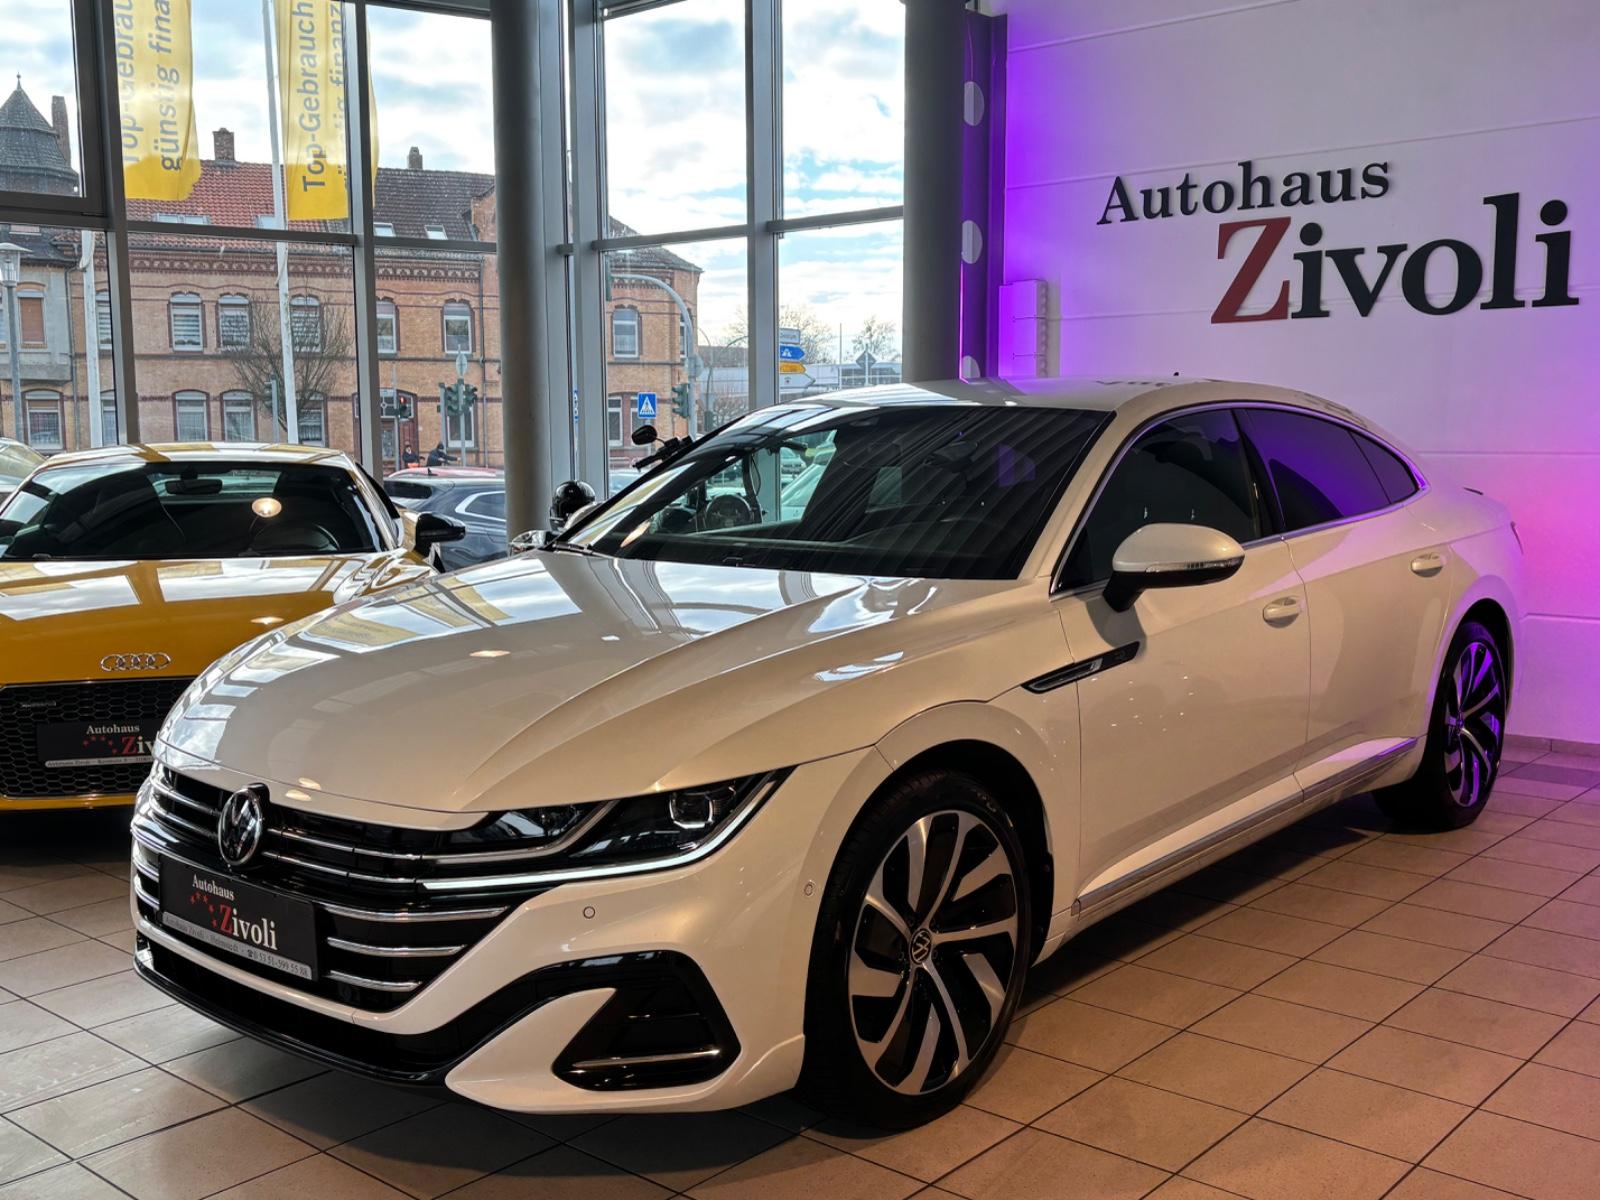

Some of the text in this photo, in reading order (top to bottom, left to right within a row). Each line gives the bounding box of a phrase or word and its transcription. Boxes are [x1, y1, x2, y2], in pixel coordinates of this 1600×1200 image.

[151, 64, 182, 170] günstig
[292, 0, 327, 192] Top-Gebrauch
[1097, 160, 1390, 226] Autohaus
[1211, 192, 1579, 324] Zivoli
[86, 724, 140, 735] Autohaus
[192, 873, 235, 901] Autohaus
[219, 904, 278, 950] Zivoli
